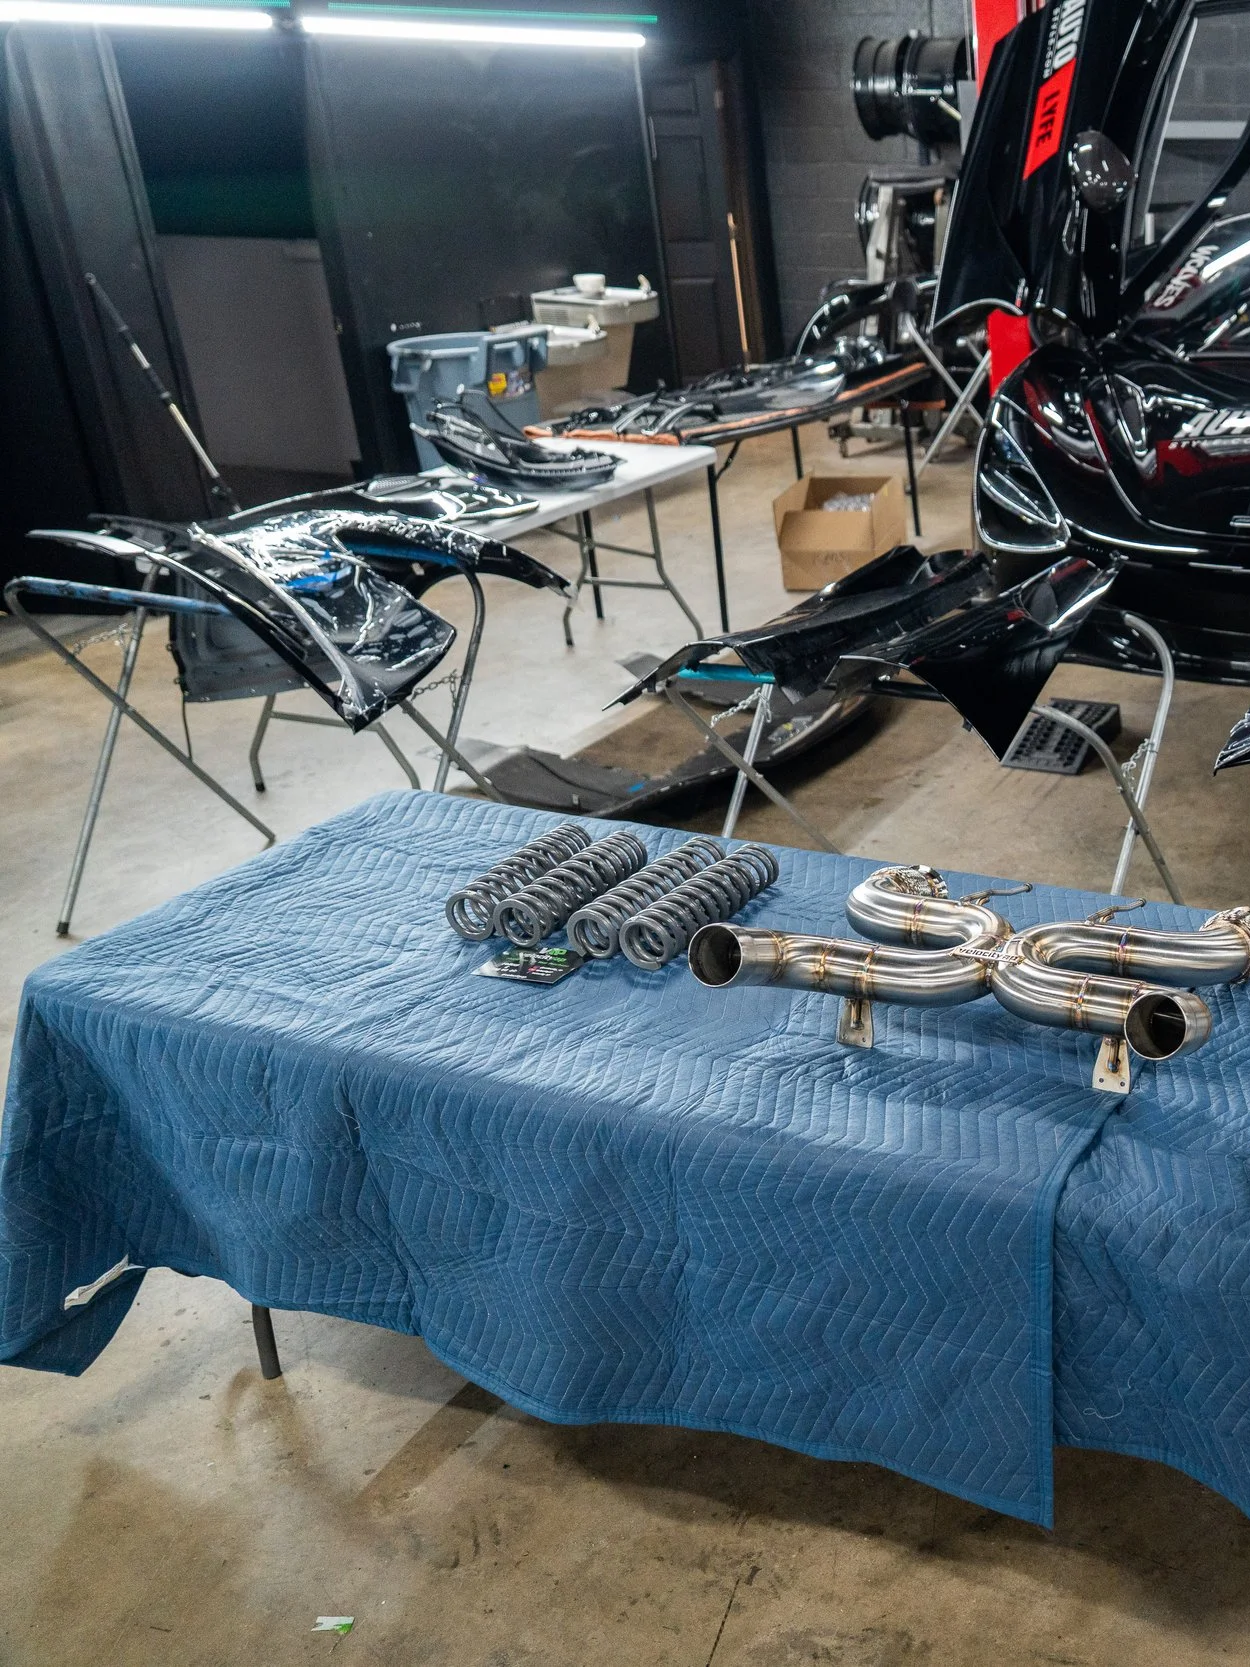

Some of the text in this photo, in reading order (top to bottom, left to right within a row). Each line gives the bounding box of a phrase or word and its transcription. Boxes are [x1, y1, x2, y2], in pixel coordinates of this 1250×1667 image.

[1036, 0, 1087, 147] AUTO LYFE
[1153, 245, 1220, 307] WOLVES
